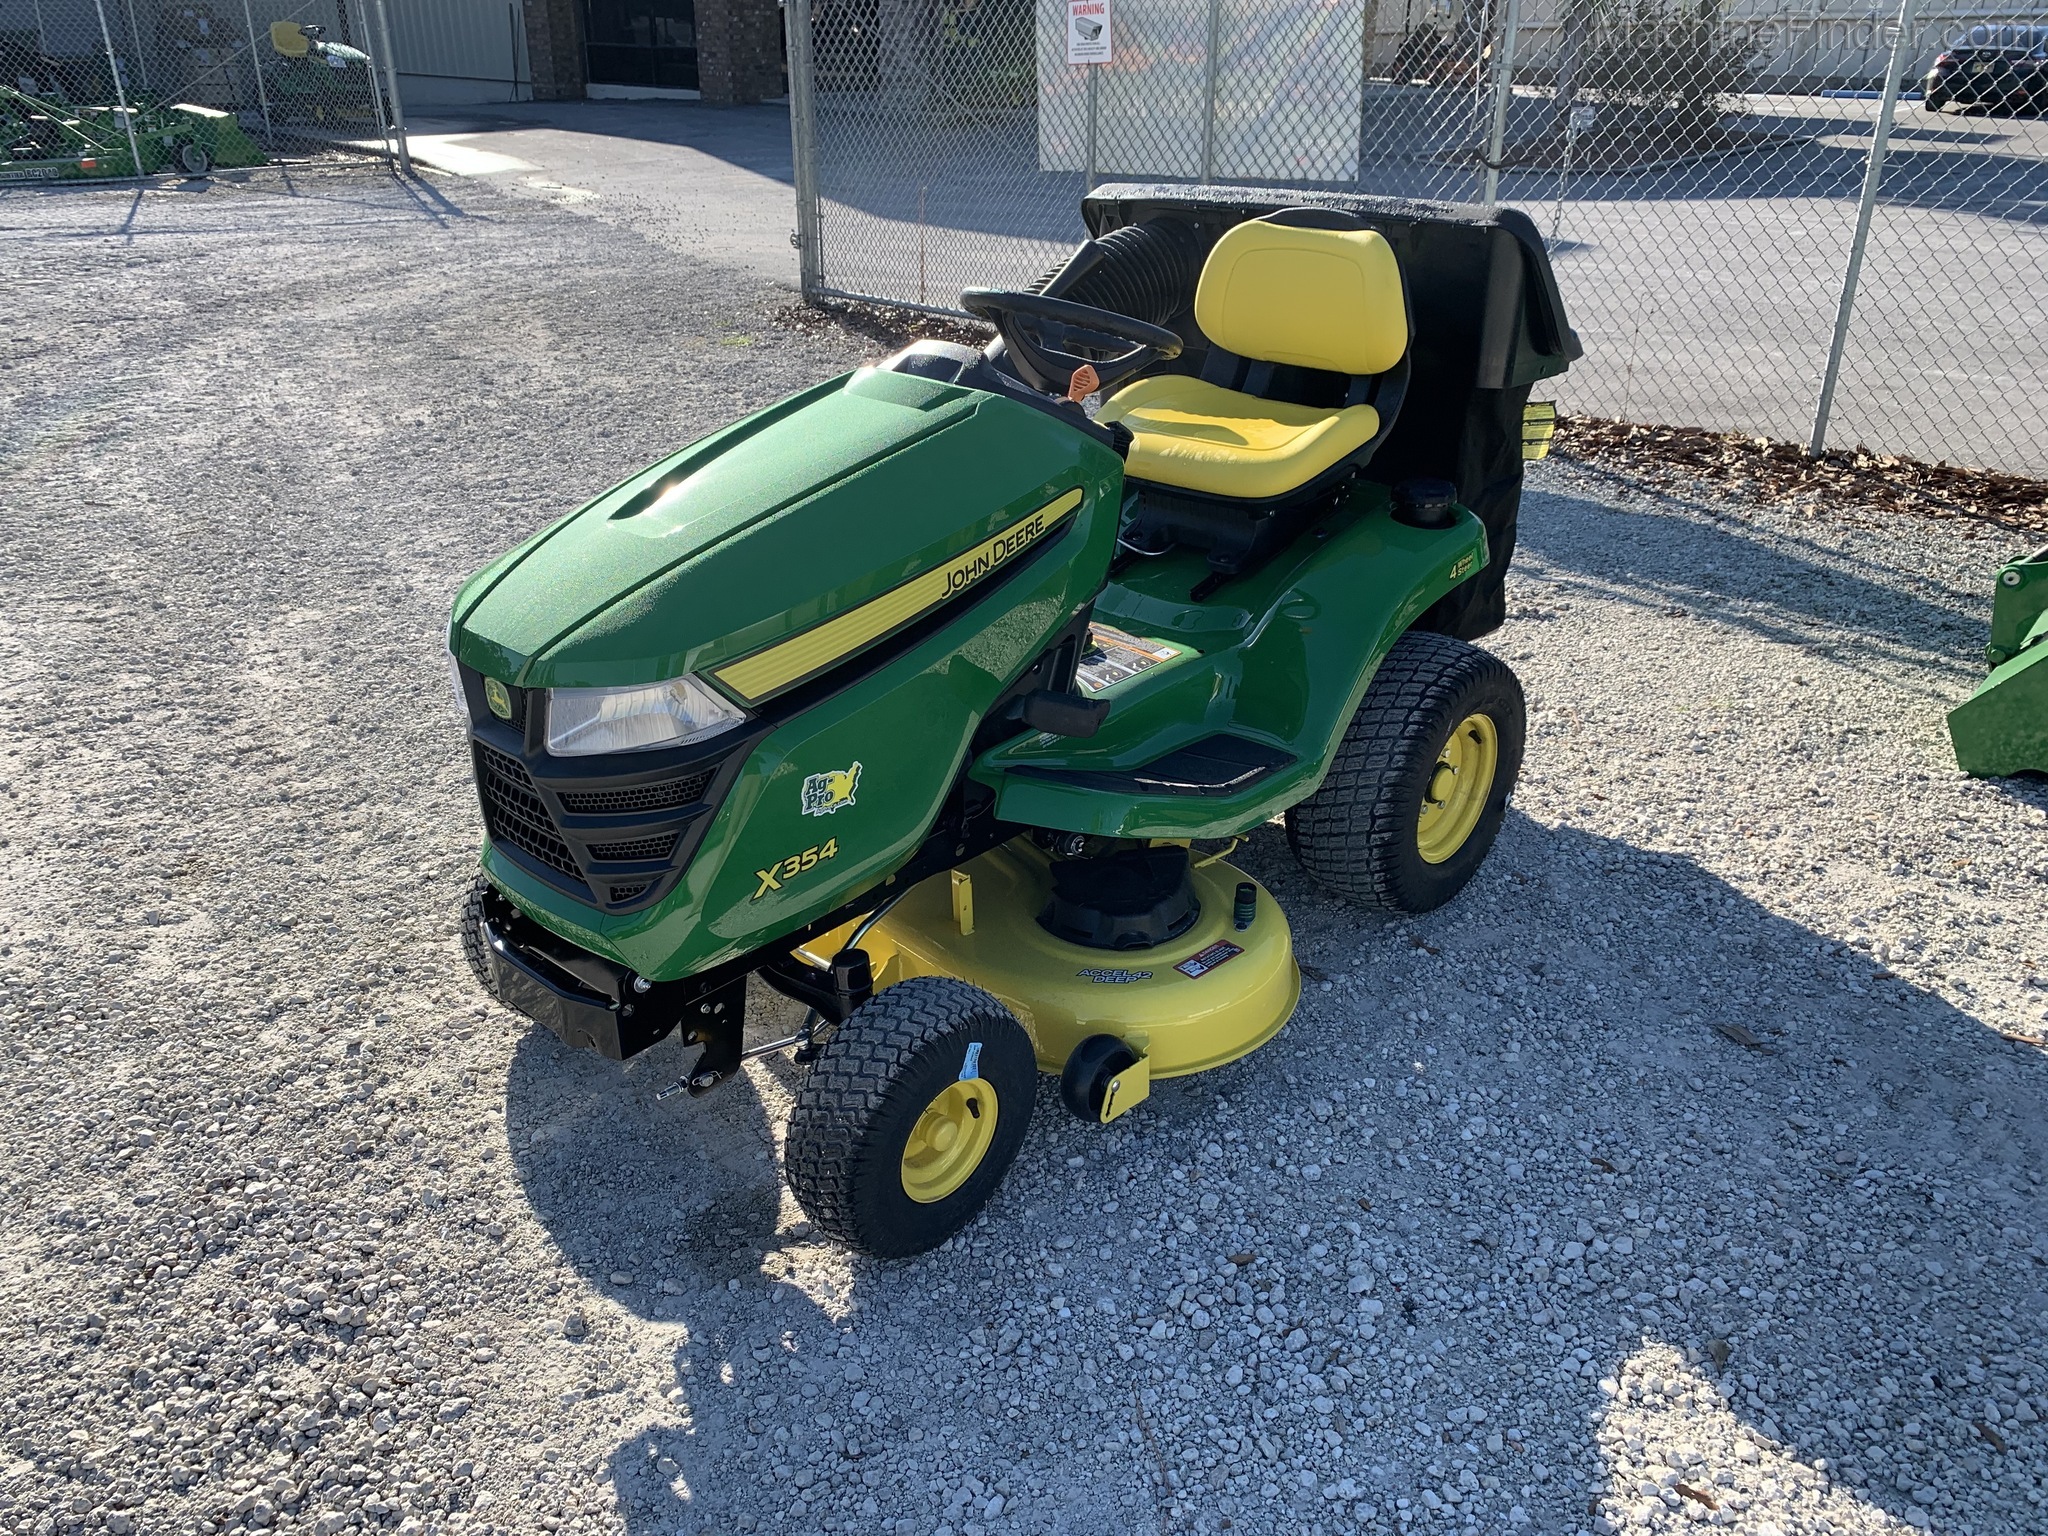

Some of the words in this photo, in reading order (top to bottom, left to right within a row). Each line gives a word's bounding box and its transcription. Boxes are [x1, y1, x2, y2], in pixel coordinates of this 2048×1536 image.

[1072, 3, 1105, 16] WARNING
[941, 552, 990, 599] JOHN
[992, 514, 1046, 565] DEERE
[805, 777, 834, 797] Ag-
[805, 790, 834, 811] Pro
[751, 837, 838, 902] X354
[1077, 969, 1134, 977] ACCEL
[1092, 976, 1138, 984] DEEP
